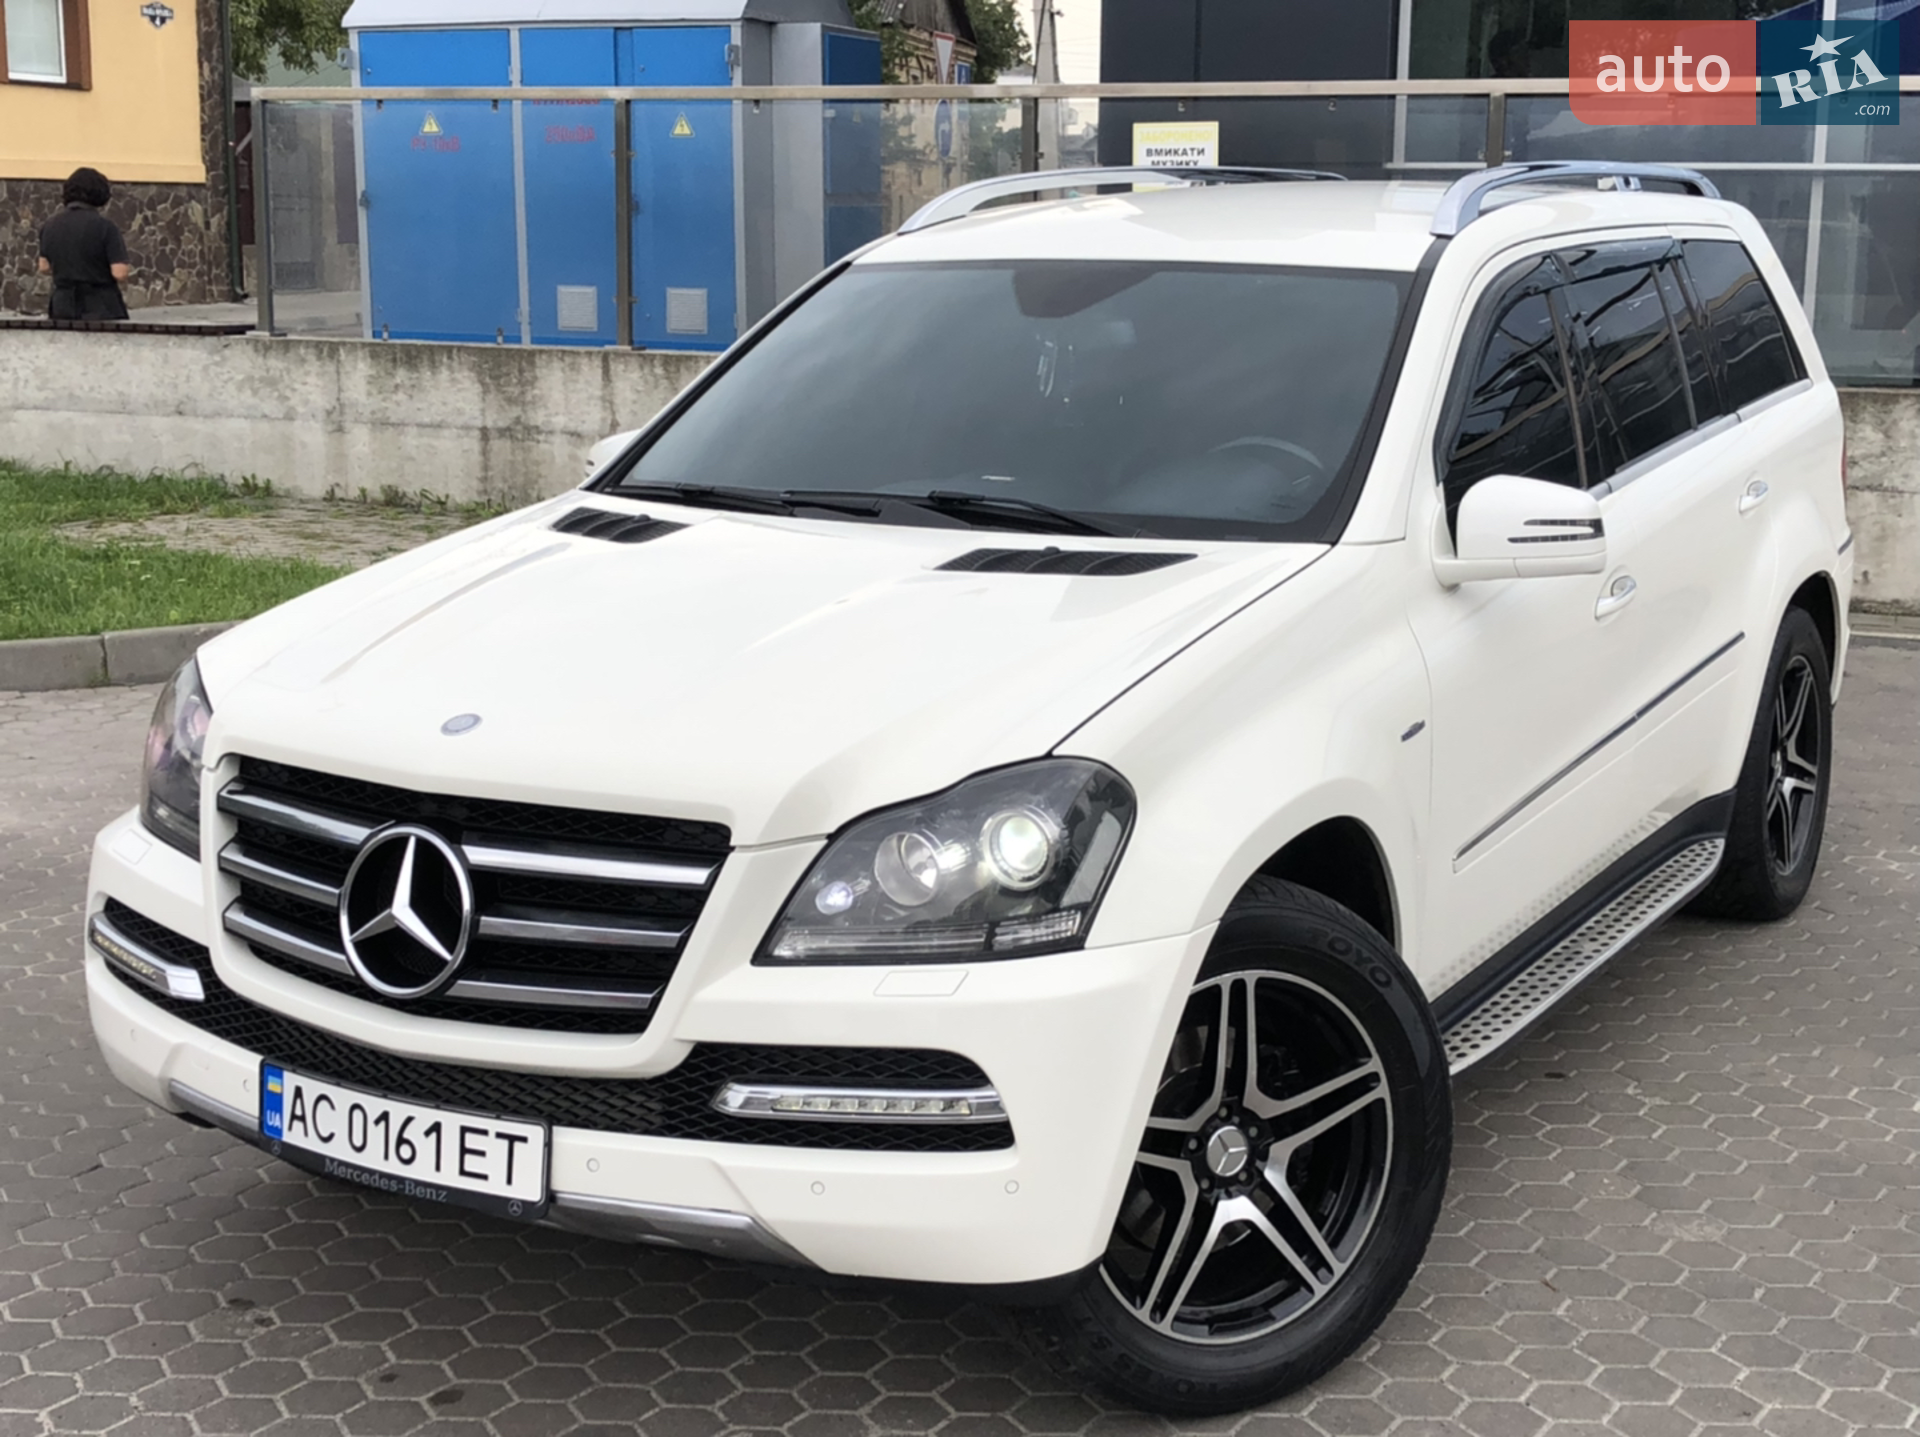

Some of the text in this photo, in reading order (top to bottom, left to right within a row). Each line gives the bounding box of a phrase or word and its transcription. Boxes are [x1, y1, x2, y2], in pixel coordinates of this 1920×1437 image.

[1146, 147, 1205, 157] ВМИКАТИ
[1307, 925, 1393, 988] TOYO
[266, 1110, 281, 1129] UA
[288, 1085, 529, 1186] AC 0161 ET
[324, 1158, 448, 1202] Mercedes-Benz
